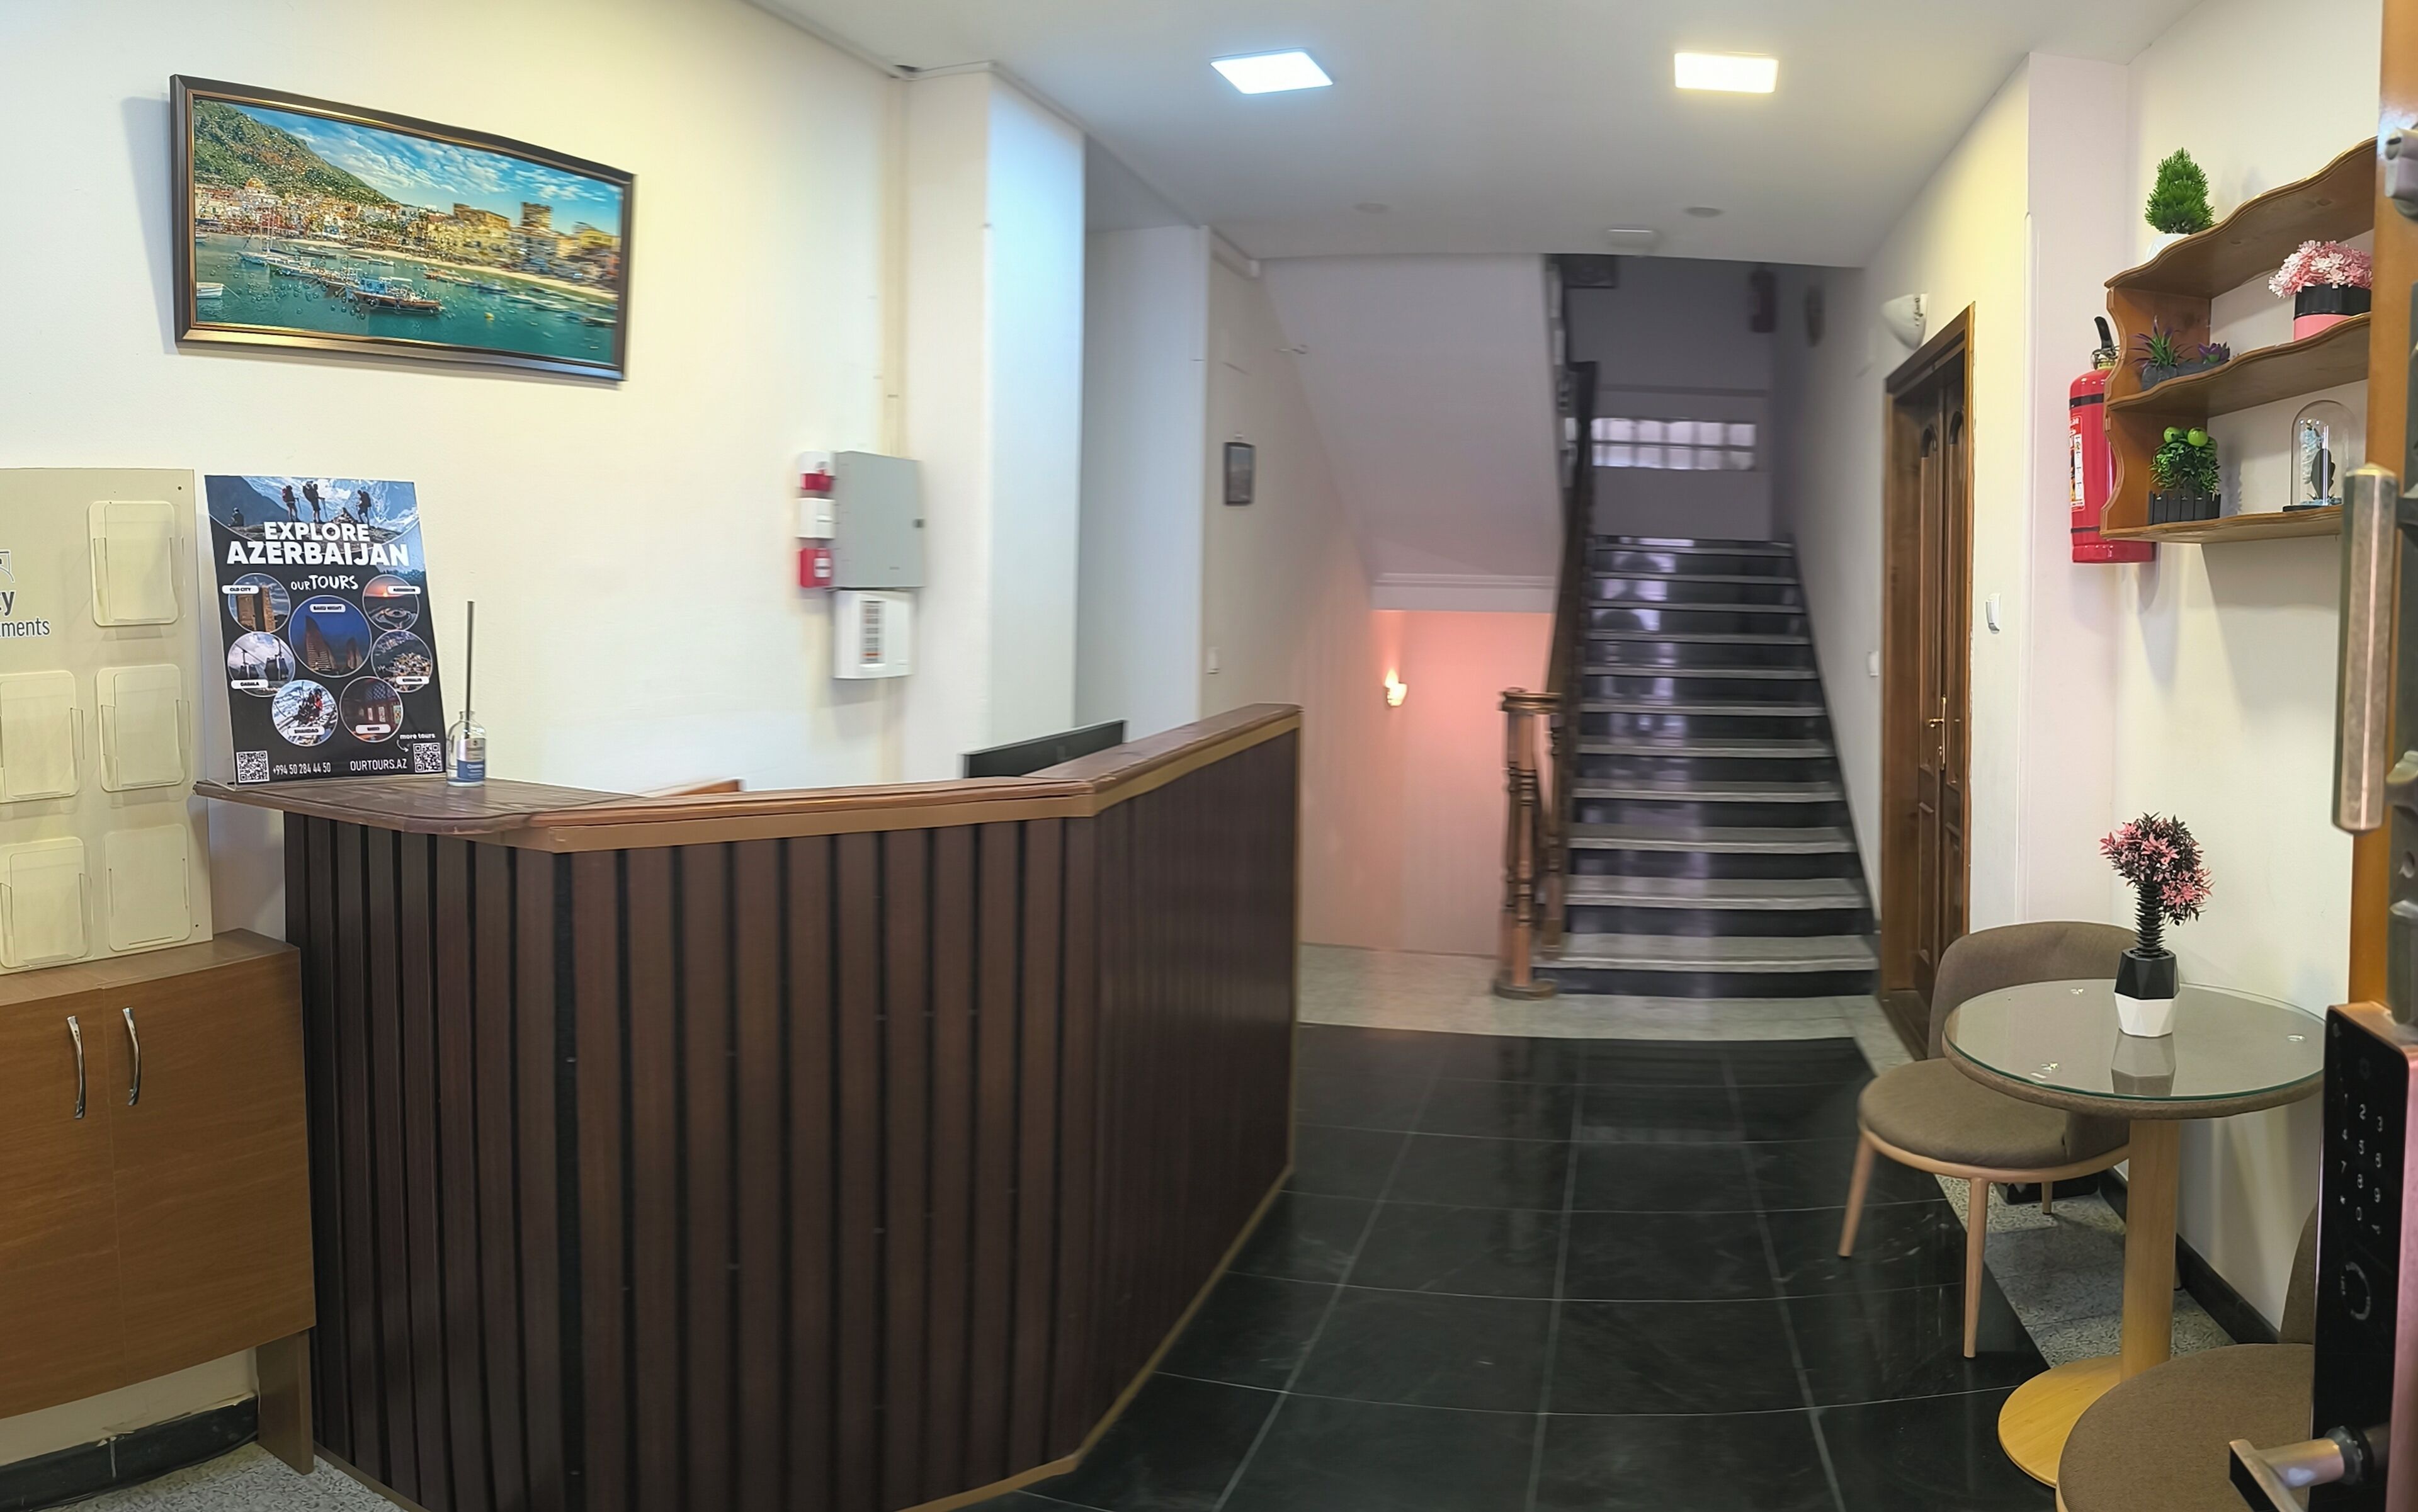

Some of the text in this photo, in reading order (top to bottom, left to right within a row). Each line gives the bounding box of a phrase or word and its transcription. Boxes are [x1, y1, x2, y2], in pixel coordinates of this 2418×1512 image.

[263, 521, 370, 542] EXPLORE
[226, 541, 410, 566] AZERBAIJAN
[0, 618, 50, 637] ments
[273, 762, 331, 775] +994 50 284 44 50
[349, 758, 407, 771] OURTOURS.AZ
[2359, 1103, 2367, 1120] 2
[2341, 1159, 2381, 1203] 7 8 9
[2355, 1205, 2363, 1221] 0
